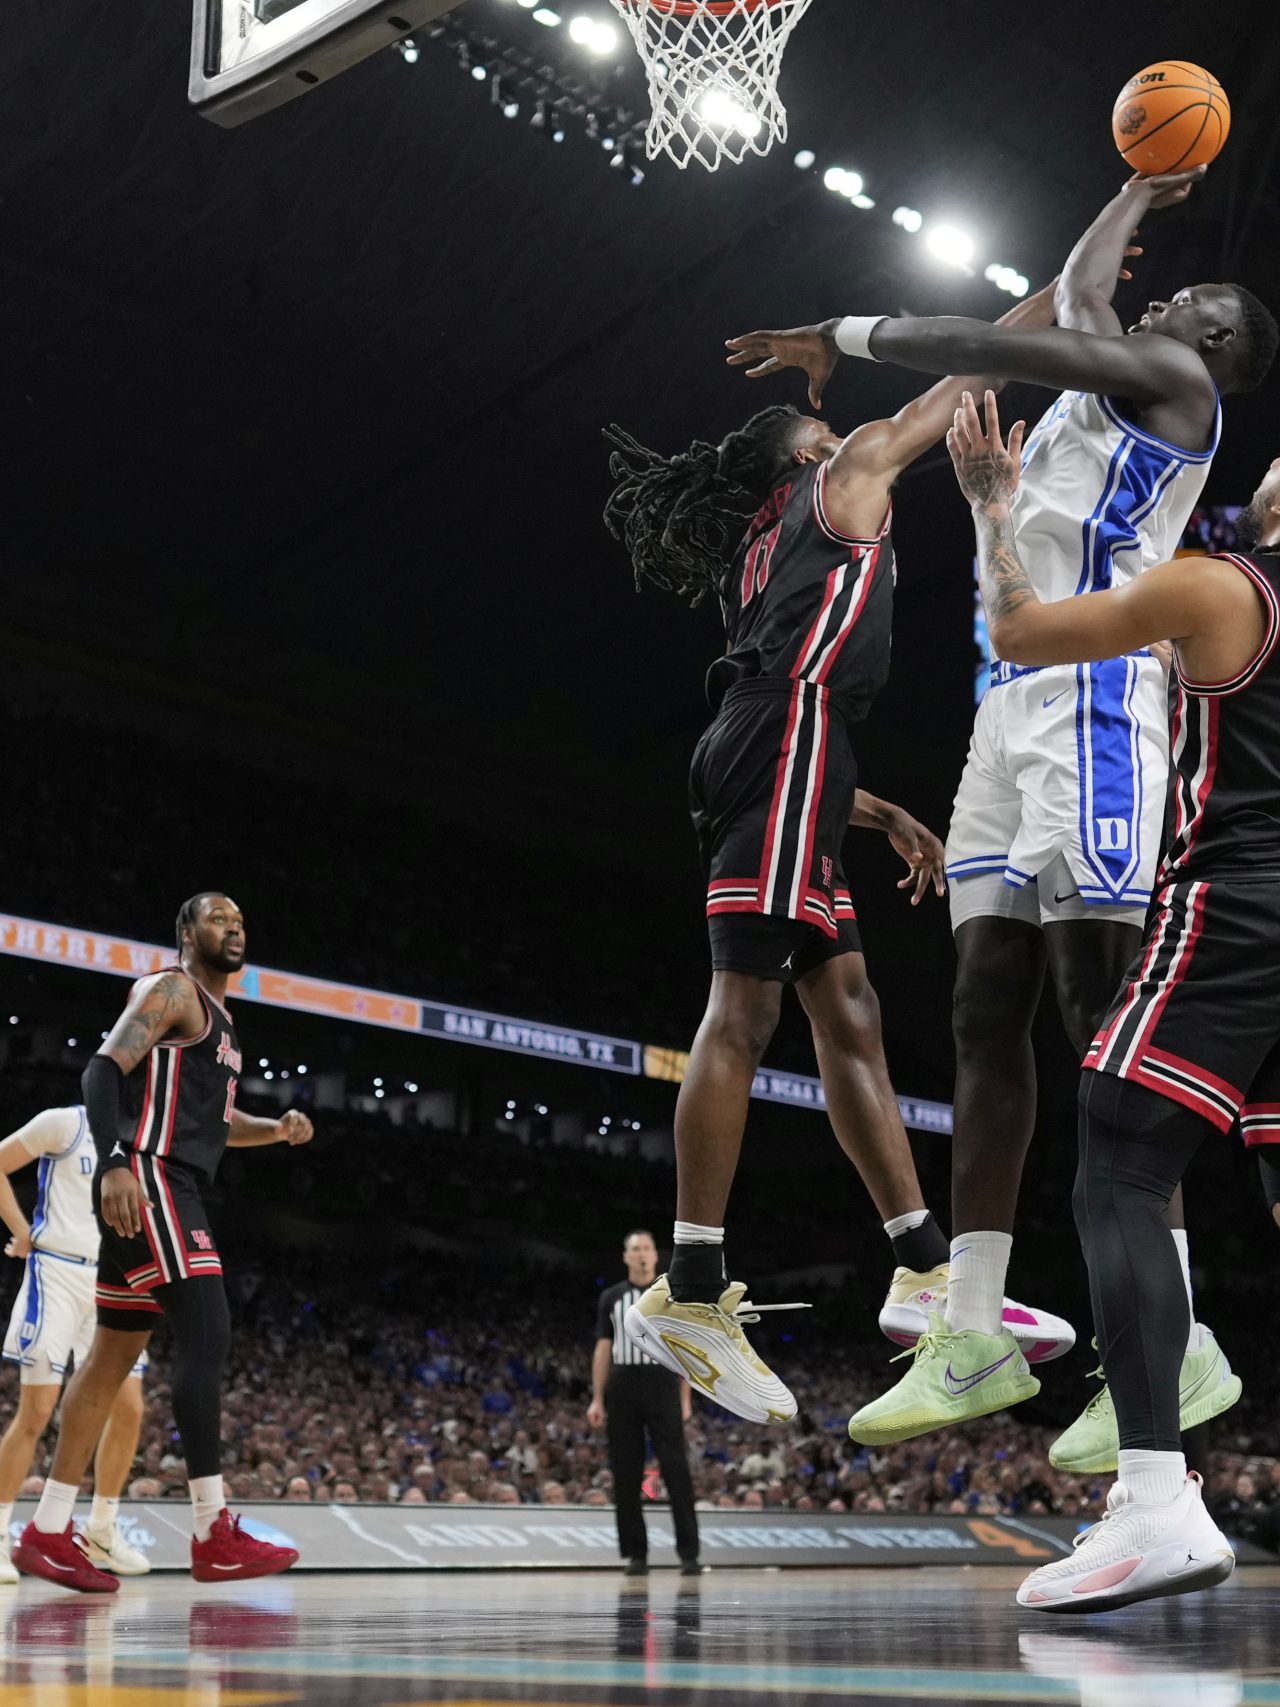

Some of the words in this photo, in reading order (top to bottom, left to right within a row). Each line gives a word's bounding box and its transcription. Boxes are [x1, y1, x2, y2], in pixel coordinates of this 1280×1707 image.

[741, 519, 784, 609] 11
[1096, 817, 1129, 850] D
[444, 1012, 487, 1038] SAN
[491, 1021, 584, 1058] ANTONIO,
[587, 1040, 614, 1063] TX
[404, 1525, 529, 1547] AND
[699, 1527, 849, 1548] THERE
[966, 1520, 1052, 1557] 4
